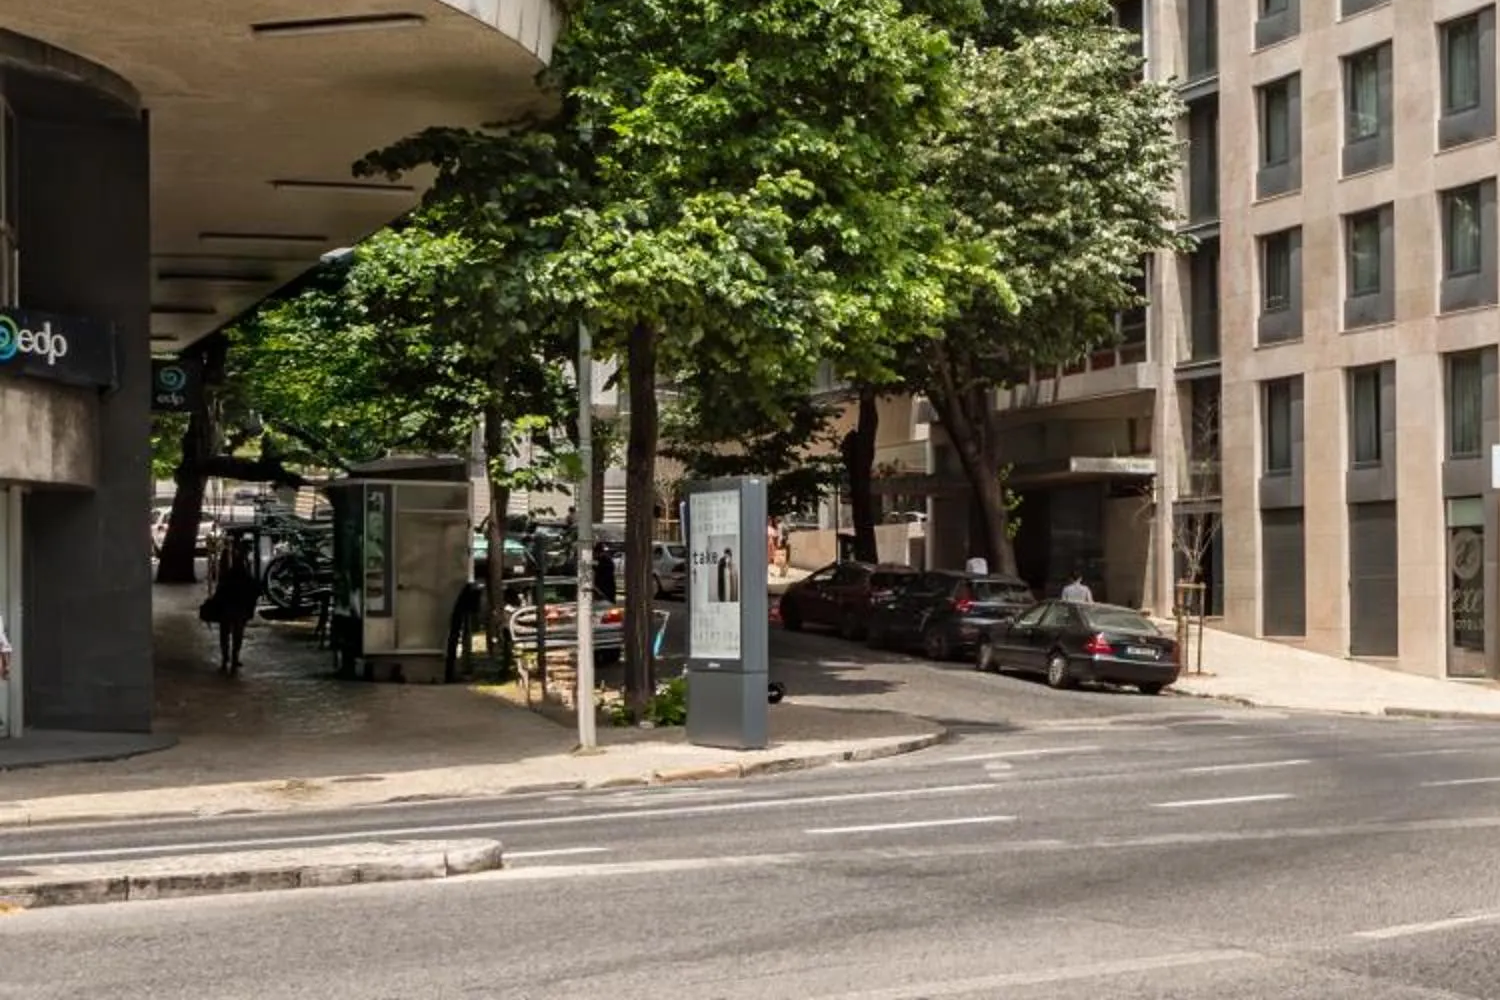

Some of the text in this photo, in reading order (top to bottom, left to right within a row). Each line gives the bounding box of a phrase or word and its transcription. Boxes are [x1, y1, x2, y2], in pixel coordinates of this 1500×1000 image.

[17, 321, 67, 365] edp
[156, 392, 184, 406] edp
[693, 551, 718, 565] take
